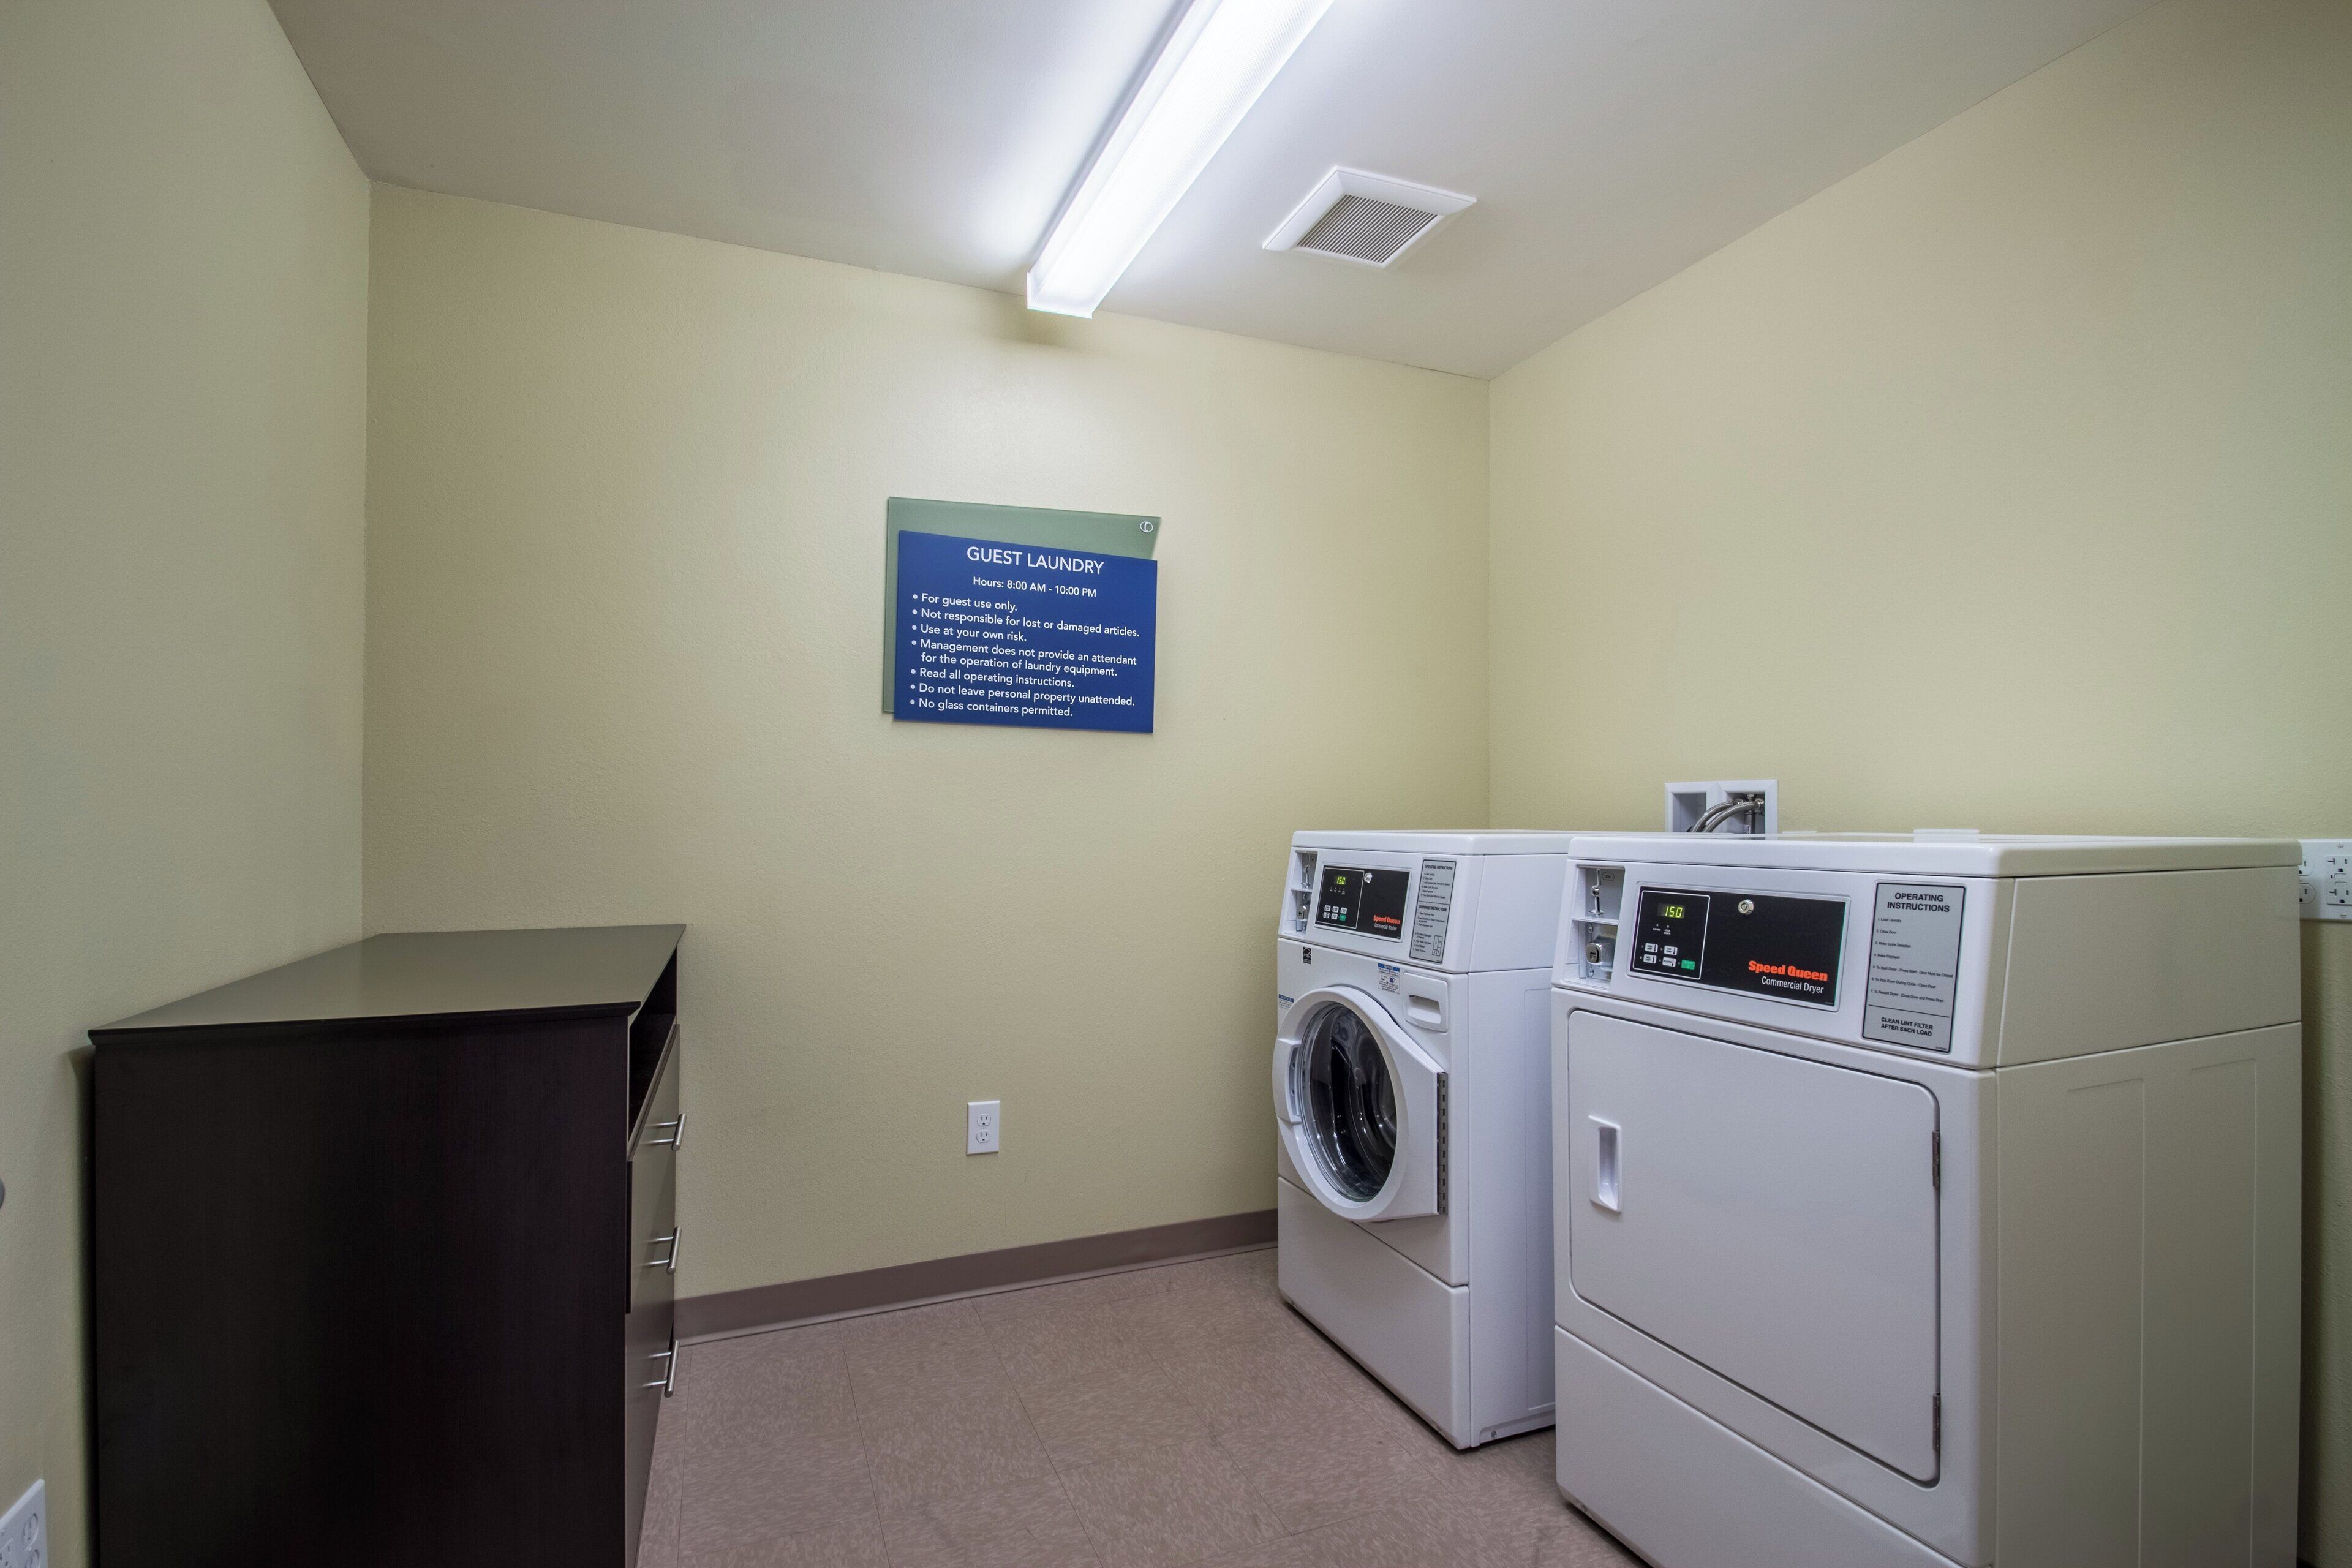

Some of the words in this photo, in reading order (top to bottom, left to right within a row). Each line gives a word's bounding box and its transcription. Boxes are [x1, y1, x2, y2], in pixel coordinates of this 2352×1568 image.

[967, 546, 1023, 566] GUEST
[1027, 552, 1104, 575] LAUNDRY
[973, 576, 1004, 588] Hours:
[1006, 579, 1027, 590] 8:00
[1029, 582, 1046, 593] AM
[1055, 584, 1080, 596] 10:00
[1082, 587, 1097, 598] PM
[921, 592, 940, 604] For
[942, 597, 971, 608] guest
[974, 600, 992, 609] use
[994, 600, 1017, 614] only.
[921, 608, 941, 619] Not
[944, 612, 1003, 625] responsible
[1005, 615, 1020, 626] for
[1023, 616, 1041, 628] lost
[1057, 620, 1102, 635] damaged
[1104, 626, 1140, 637] articles.
[921, 623, 941, 635] Use
[943, 627, 954, 636] at
[956, 629, 980, 639] your
[982, 631, 1004, 640] own
[1006, 631, 1027, 642] risk.
[920, 638, 989, 654] Management
[991, 644, 1016, 655] does
[1019, 649, 1036, 657] not
[1038, 650, 1075, 661] provide
[1091, 654, 1137, 665] attendant
[921, 653, 937, 663] for
[939, 653, 957, 665] the
[959, 657, 1009, 668] operation
[1011, 659, 1023, 669] of
[1025, 660, 1061, 674] laundry
[1063, 665, 1117, 677] equipment.
[919, 667, 946, 679] Read
[949, 669, 961, 680] all
[963, 673, 1013, 686] operating
[1016, 674, 1074, 688] instructions.
[919, 682, 935, 693] Do
[938, 685, 956, 695] not
[958, 684, 986, 696] leave
[987, 689, 1031, 700] personal
[1033, 693, 1076, 705] property
[1078, 695, 1135, 706] unattended.
[919, 698, 935, 709] No
[937, 699, 964, 712] glass
[967, 703, 1019, 714] containers
[1022, 706, 1073, 717] permitted.
[1887, 902, 1950, 913] INSTRUCTIONS
[1895, 892, 1944, 902] OPERATING
[1665, 907, 1683, 918] 150
[1749, 960, 1786, 975] Speed
[1787, 965, 1828, 981] Queen
[1762, 976, 1802, 990] Commercial
[1804, 982, 1824, 994] Dryer
